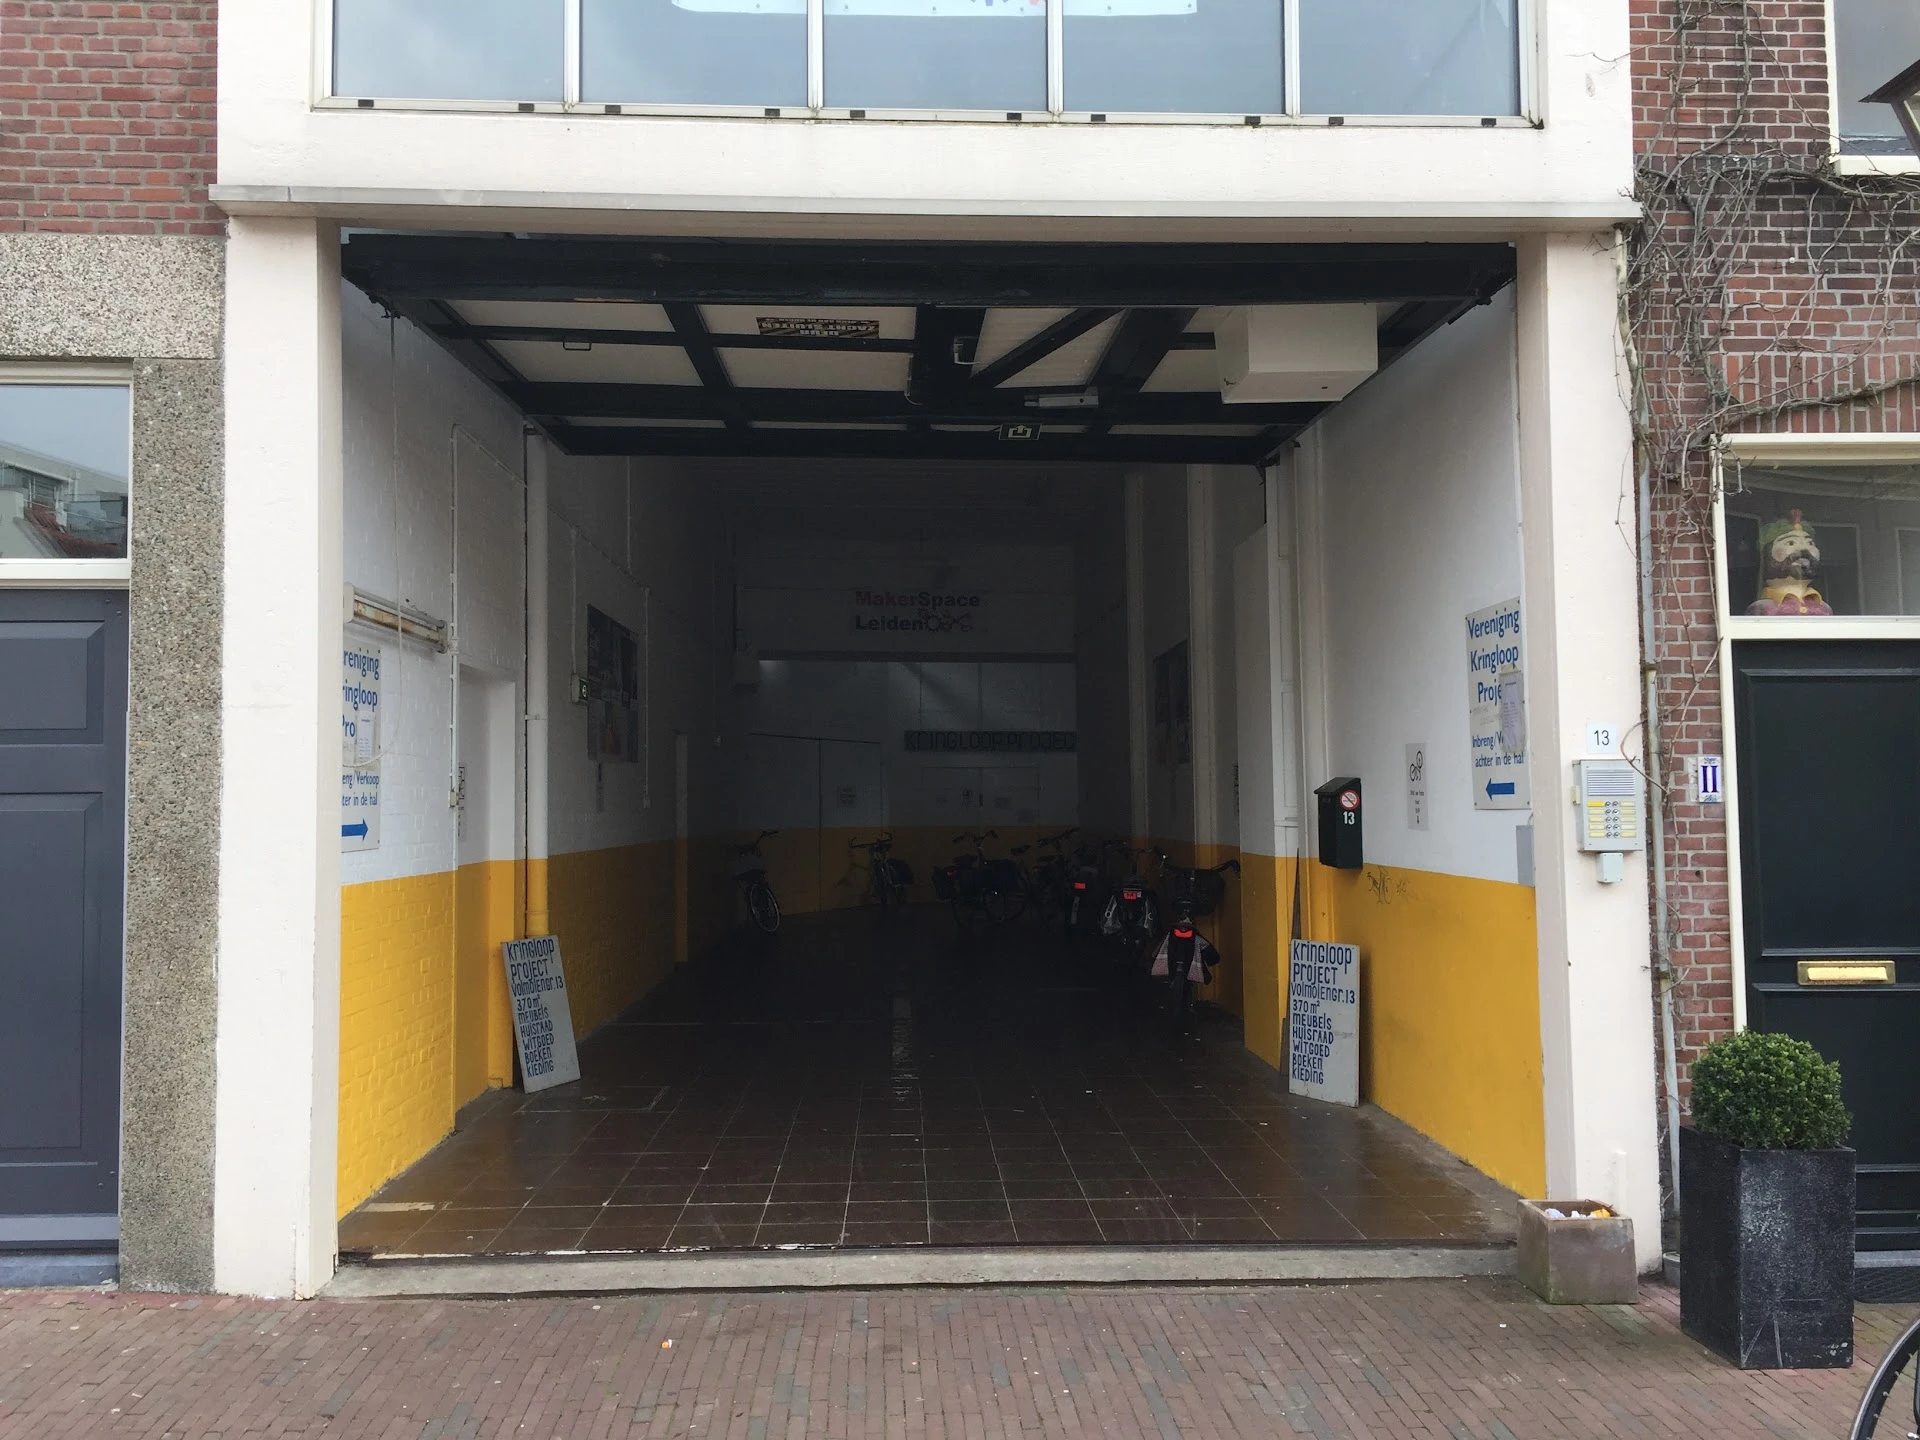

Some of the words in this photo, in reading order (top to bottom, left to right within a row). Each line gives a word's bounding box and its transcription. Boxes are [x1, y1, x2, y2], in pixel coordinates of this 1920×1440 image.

[855, 591, 980, 610] MakerSpace
[855, 615, 924, 631] Leiden
[1467, 607, 1520, 639] Vereniging
[343, 648, 380, 681] reniging
[1470, 645, 1519, 675] Kringloop
[342, 678, 378, 713] ingloop
[1478, 678, 1502, 707] Proje
[1593, 729, 1610, 746] 13
[1475, 753, 1493, 768] achter
[1495, 752, 1502, 766] in
[1503, 751, 1512, 765] de
[1513, 751, 1524, 765] hal
[353, 791, 359, 807] in
[361, 791, 368, 806] de
[369, 791, 378, 806] hal
[1343, 811, 1355, 825] 13
[517, 997, 533, 1012] 370
[1292, 999, 1308, 1013] 370
